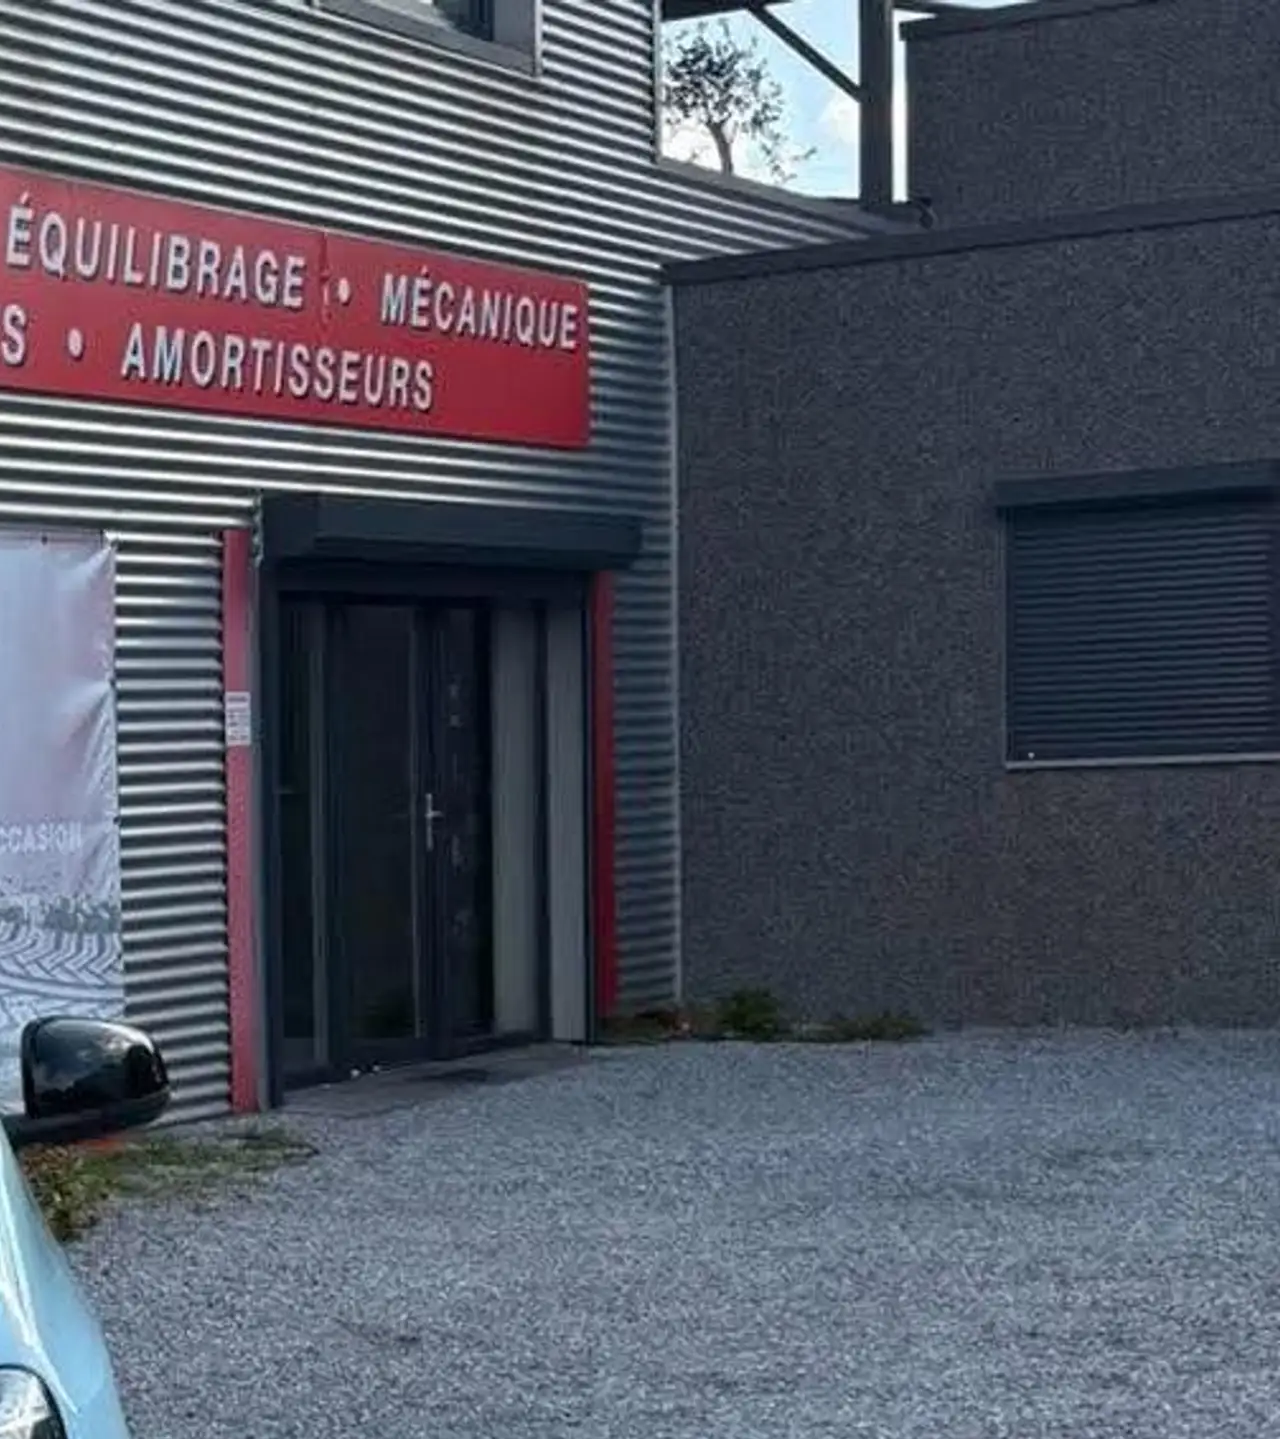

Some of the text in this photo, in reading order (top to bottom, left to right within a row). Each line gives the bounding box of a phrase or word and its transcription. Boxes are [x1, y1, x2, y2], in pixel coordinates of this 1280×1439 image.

[5, 192, 307, 310] ÉQUILIBRAGE
[380, 266, 580, 351] MÉCANIQUE
[120, 323, 435, 412] AMORTISSEURS
